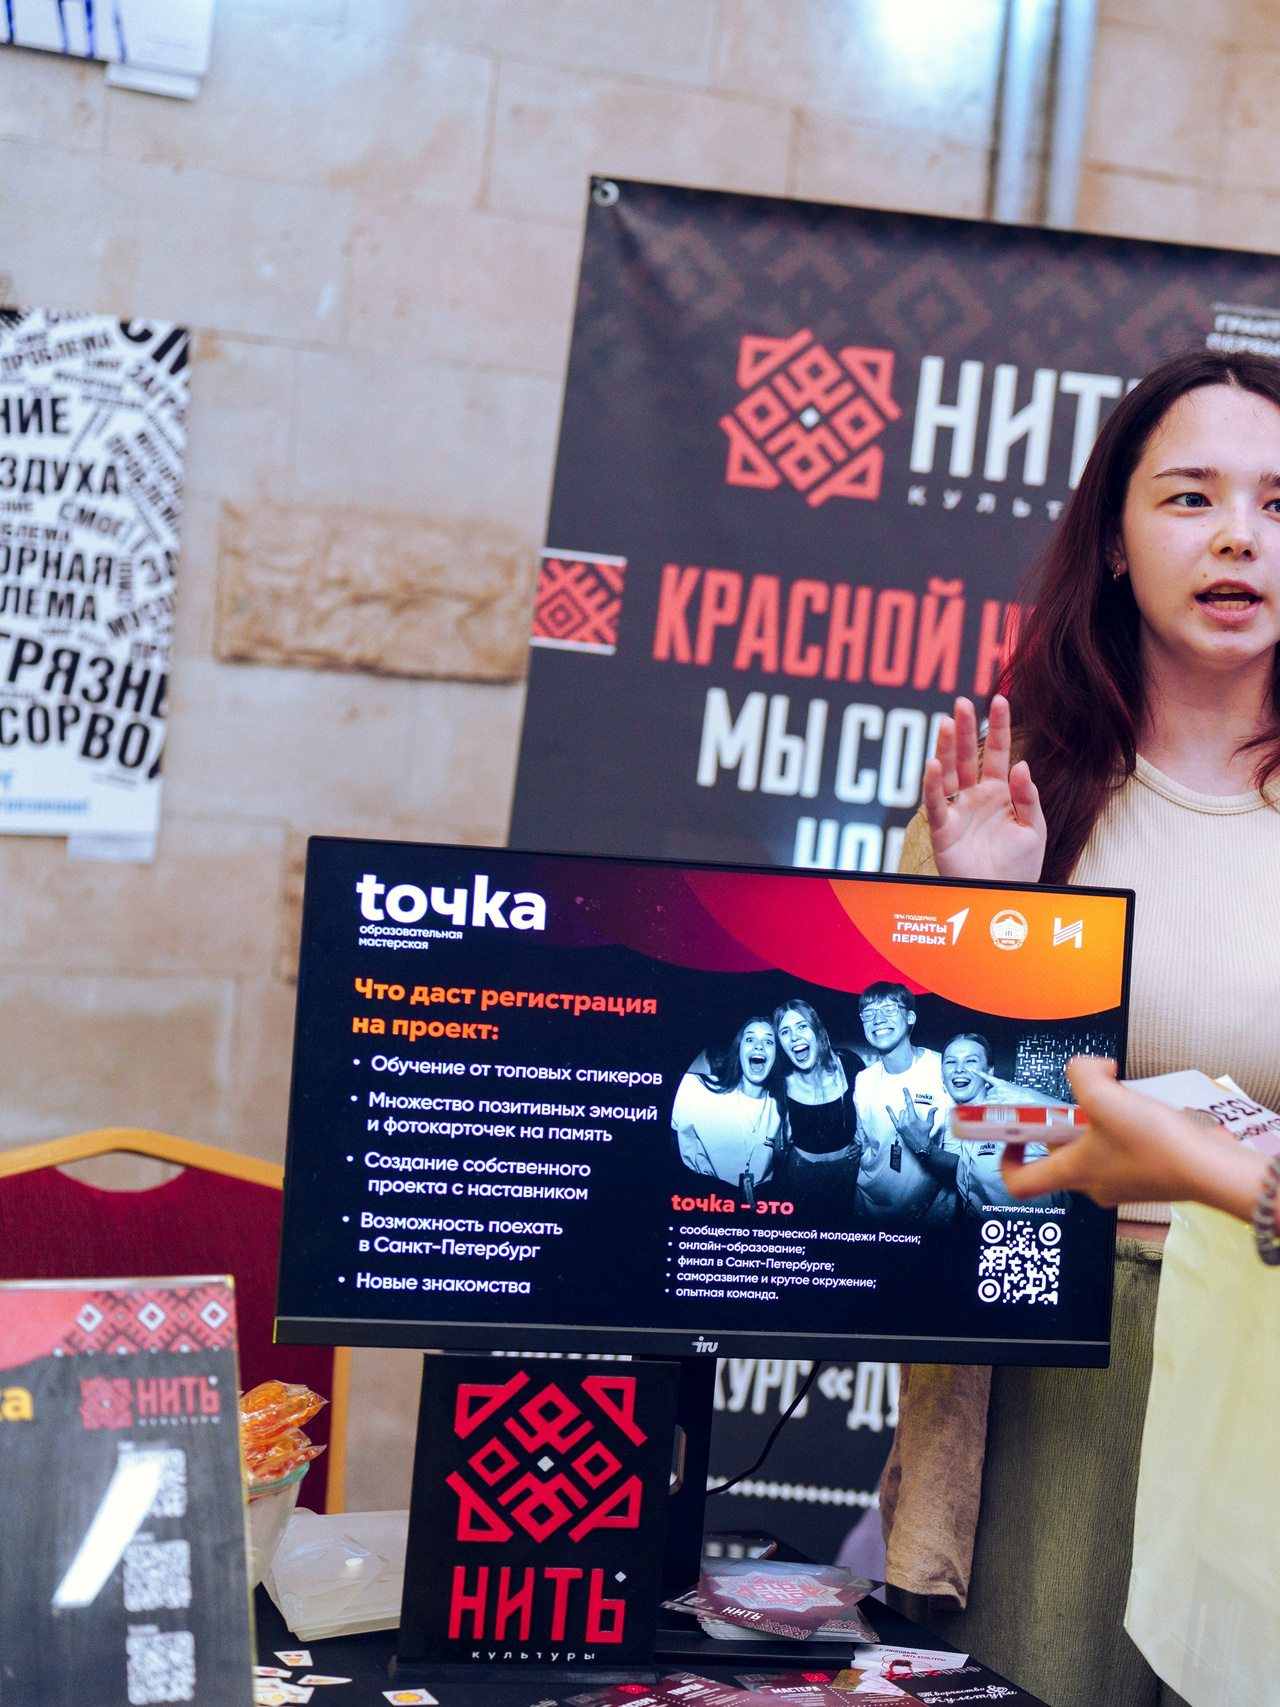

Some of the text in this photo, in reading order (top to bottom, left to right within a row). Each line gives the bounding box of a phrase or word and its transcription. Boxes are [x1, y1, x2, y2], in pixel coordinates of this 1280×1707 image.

[910, 354, 1140, 491] НИТ
[907, 484, 1064, 522] КУЛЬТ
[652, 563, 966, 694] КРАСНОЙ
[0, 632, 168, 719] РЯЗН
[697, 687, 828, 799] МЫ
[359, 924, 463, 939] образовательная
[892, 933, 945, 945] ПЕРВЫХ
[897, 922, 947, 933] ГРАНТЫ
[358, 938, 429, 950] мастерская
[355, 978, 657, 1016] Что даст регистрация
[353, 1017, 499, 1042] на проект:
[370, 1054, 662, 1087] Обучение от топовых спикеров
[368, 1091, 658, 1122] Множество позитивных эмоций
[367, 1116, 613, 1142] и фотокарточек на память
[364, 1151, 591, 1177] Создание собственного
[368, 1179, 588, 1200] проекта с наставником
[756, 1201, 794, 1215] это
[982, 1205, 1034, 1213] РЕГИСТРИРУЙСЯ
[360, 1211, 563, 1235] Возможность поехать
[679, 1225, 921, 1245] сообщество творческой молодежи России;
[359, 1236, 541, 1261] в Санкт-Петербург
[678, 1241, 805, 1255] онлайн-образование;
[677, 1255, 714, 1267] финал
[725, 1257, 834, 1272] Санкт-Петербурге;
[356, 1272, 531, 1294] Новые знакомства
[676, 1273, 759, 1284] саморазвитие
[770, 1276, 810, 1286] крутое
[812, 1277, 876, 1288] окружение;
[675, 1288, 778, 1300] опытная команда.
[136, 1375, 220, 1417] НИТЬ
[448, 1566, 626, 1643] НИТЬ
[721, 1606, 763, 1620] НИТЬ
[770, 1686, 821, 1694] МАСТЕРА
